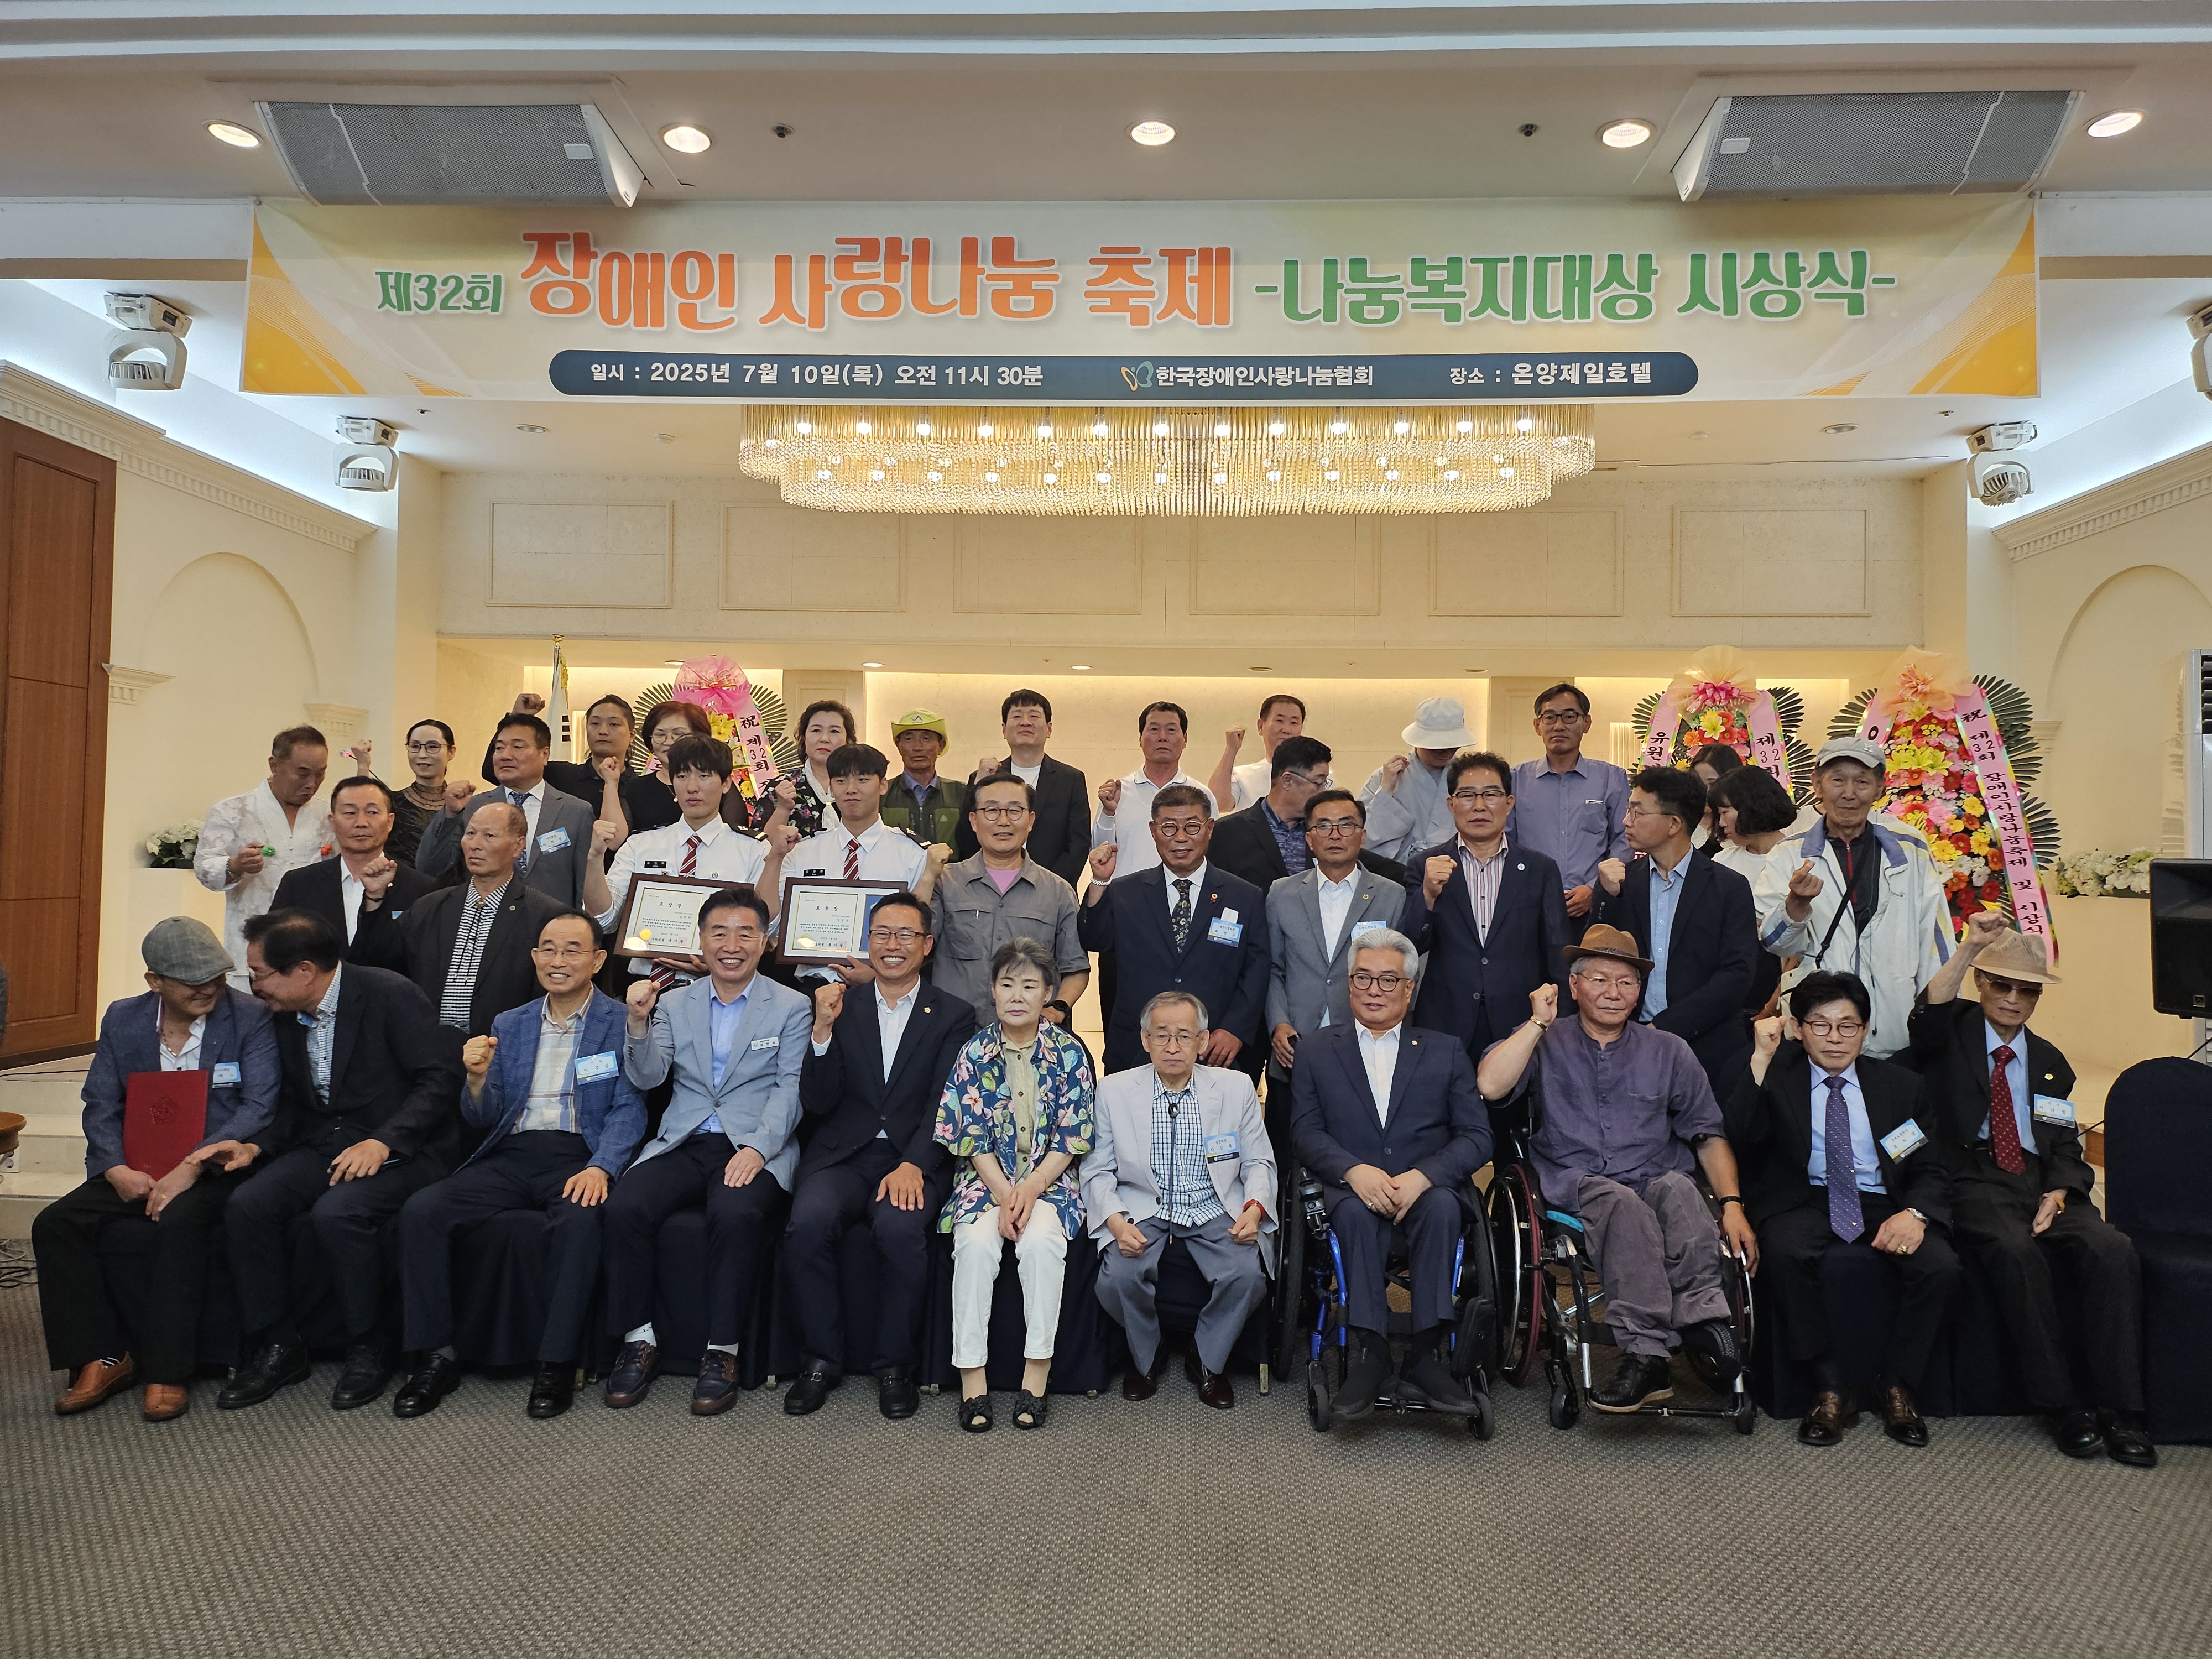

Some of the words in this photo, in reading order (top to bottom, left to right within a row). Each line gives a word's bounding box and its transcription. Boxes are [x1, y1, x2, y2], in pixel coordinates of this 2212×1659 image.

[375, 271, 502, 312] 제32회
[521, 232, 735, 330] 장애인
[759, 236, 1060, 330] 사랑나눔
[1084, 246, 1232, 326] 축제
[591, 363, 624, 381] 일시
[651, 362, 730, 383] 2025년
[743, 363, 778, 384] 7월
[791, 363, 883, 386] 10일(목)
[895, 365, 936, 385] 오전
[945, 365, 989, 386] 11시
[997, 366, 1044, 386] 30분
[1156, 365, 1373, 387] 한국장애인사랑나눔협회
[1449, 367, 1484, 384] 장소
[1512, 362, 1652, 385] 온양제일호텔
[739, 715, 760, 729] 祝
[1960, 709, 1988, 723] 祝
[746, 735, 769, 772] 제32회
[1646, 732, 1670, 766] 유원
[1968, 730, 1995, 761] 제32회
[2012, 879, 2033, 891] 및
